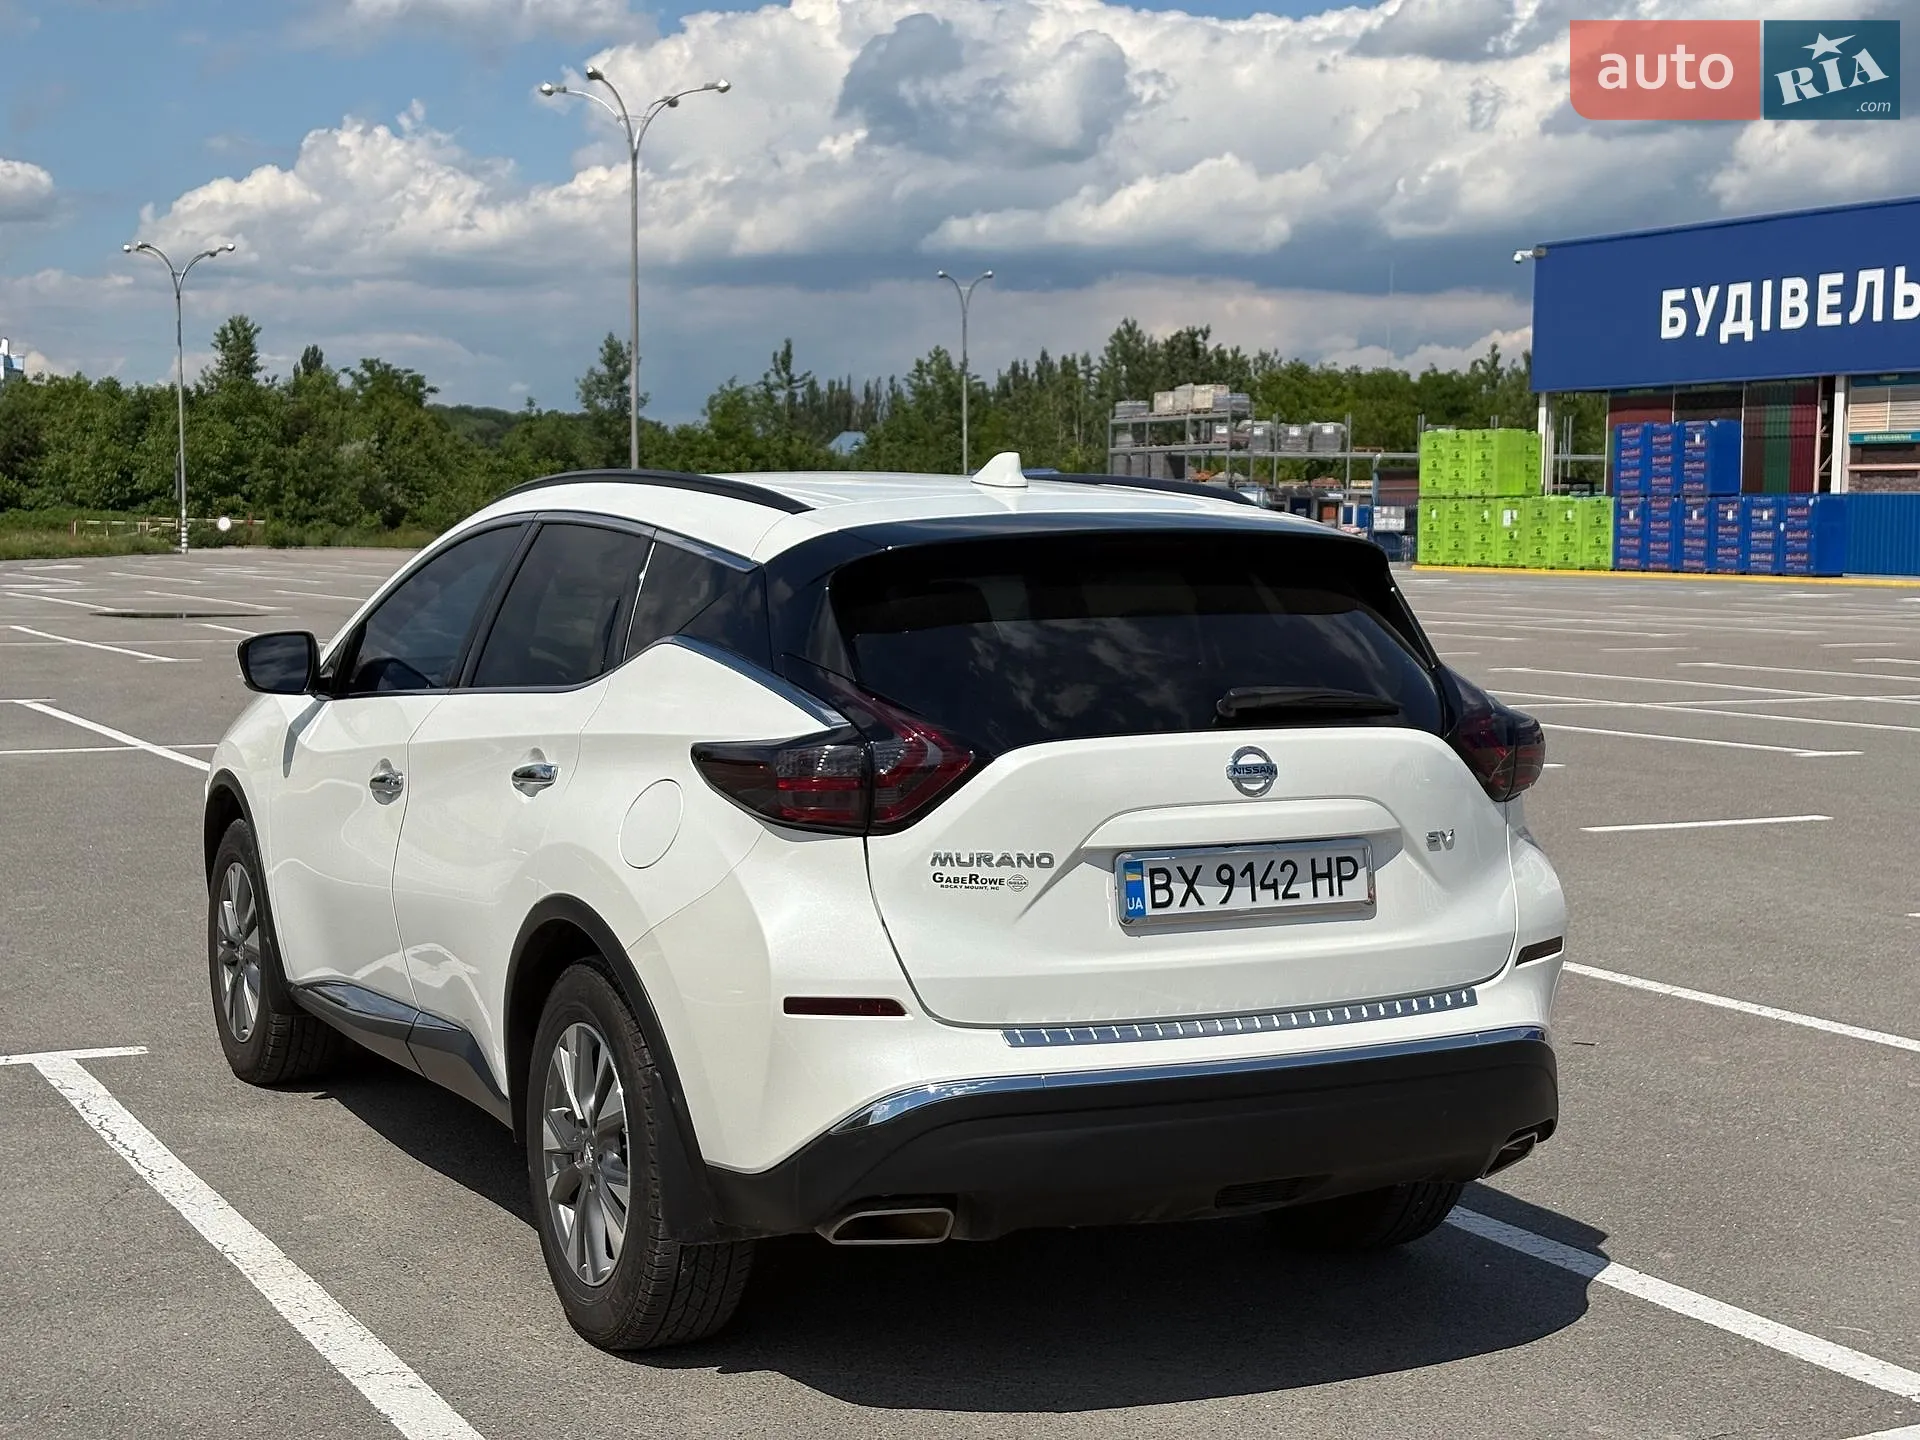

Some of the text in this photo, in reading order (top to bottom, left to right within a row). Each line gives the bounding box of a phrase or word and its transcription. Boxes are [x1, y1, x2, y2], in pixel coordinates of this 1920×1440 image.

[1660, 265, 1920, 344] БУДІВЕЛЬ
[1233, 765, 1274, 776] NISSAN
[1425, 829, 1455, 851] SV
[930, 851, 1055, 868] MURANO
[1149, 856, 1359, 909] BX 9142 HP
[1127, 896, 1144, 911] UA
